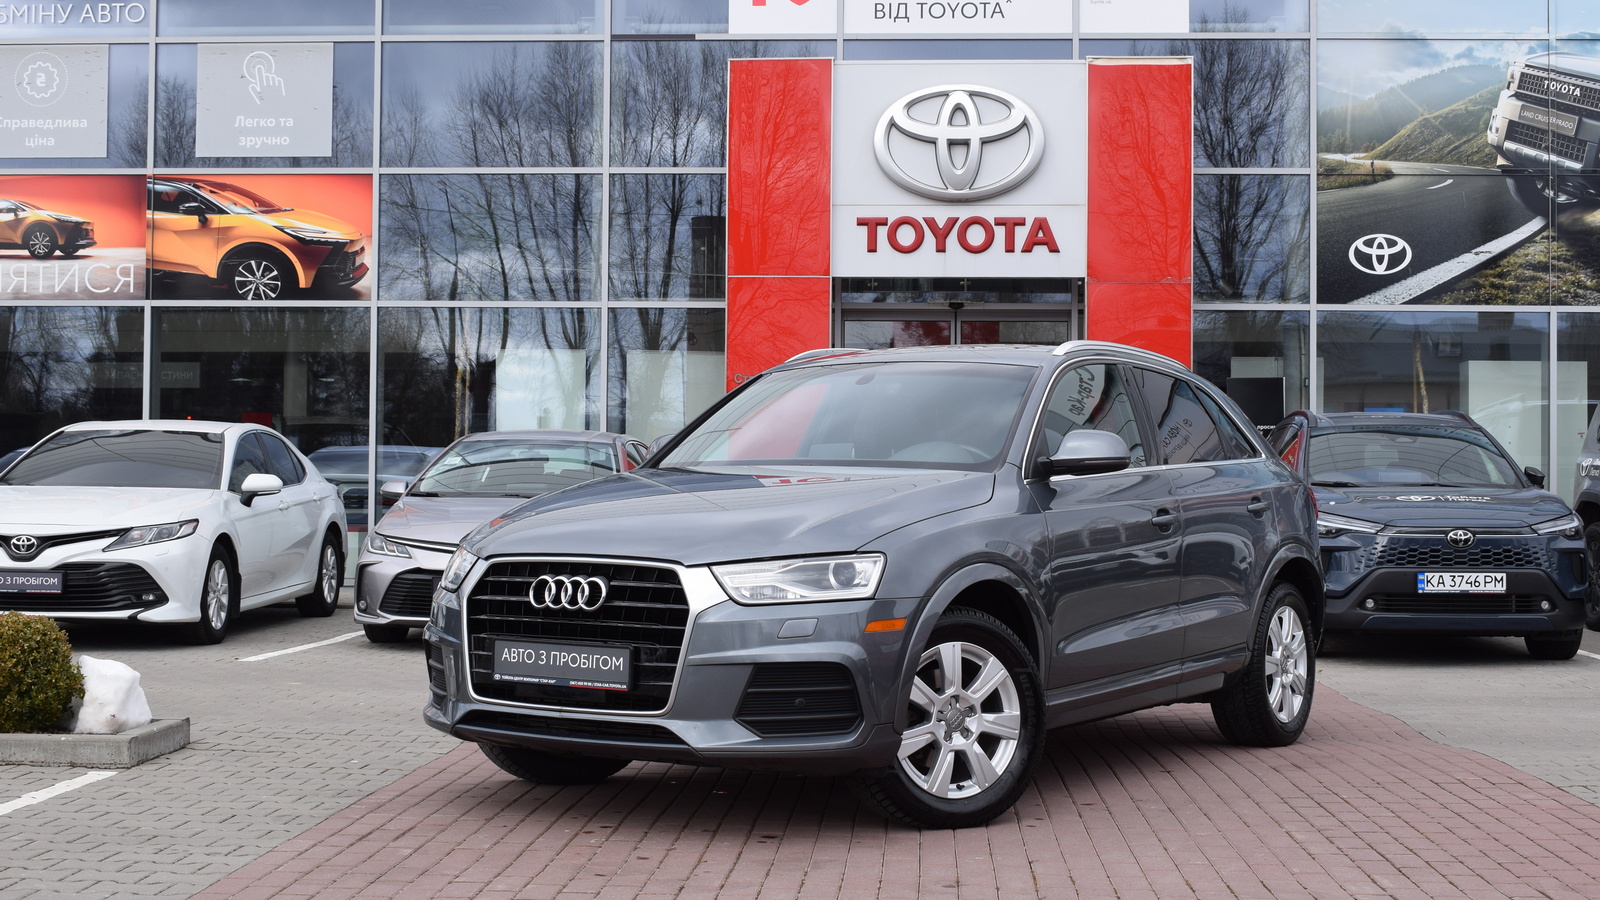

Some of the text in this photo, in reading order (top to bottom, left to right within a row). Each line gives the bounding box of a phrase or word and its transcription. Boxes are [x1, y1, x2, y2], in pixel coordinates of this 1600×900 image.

[79, 2, 146, 23] АВТО
[874, 2, 910, 23] ВІД
[1544, 81, 1580, 96] TOYOTA
[0, 117, 88, 131] праведлива
[234, 115, 294, 127] Легко та
[1521, 110, 1573, 128] LAND CRUISER PRADO
[25, 134, 55, 148] ціна
[238, 136, 290, 149] зручно
[856, 216, 1061, 254] TOYOTA
[0, 263, 135, 293] ЯТИСЯ
[13, 577, 57, 585] ПРОБІГОМ
[1449, 574, 1481, 588] 3746
[501, 647, 536, 664] АВТО
[550, 651, 624, 671] ПРОБІГОМ
